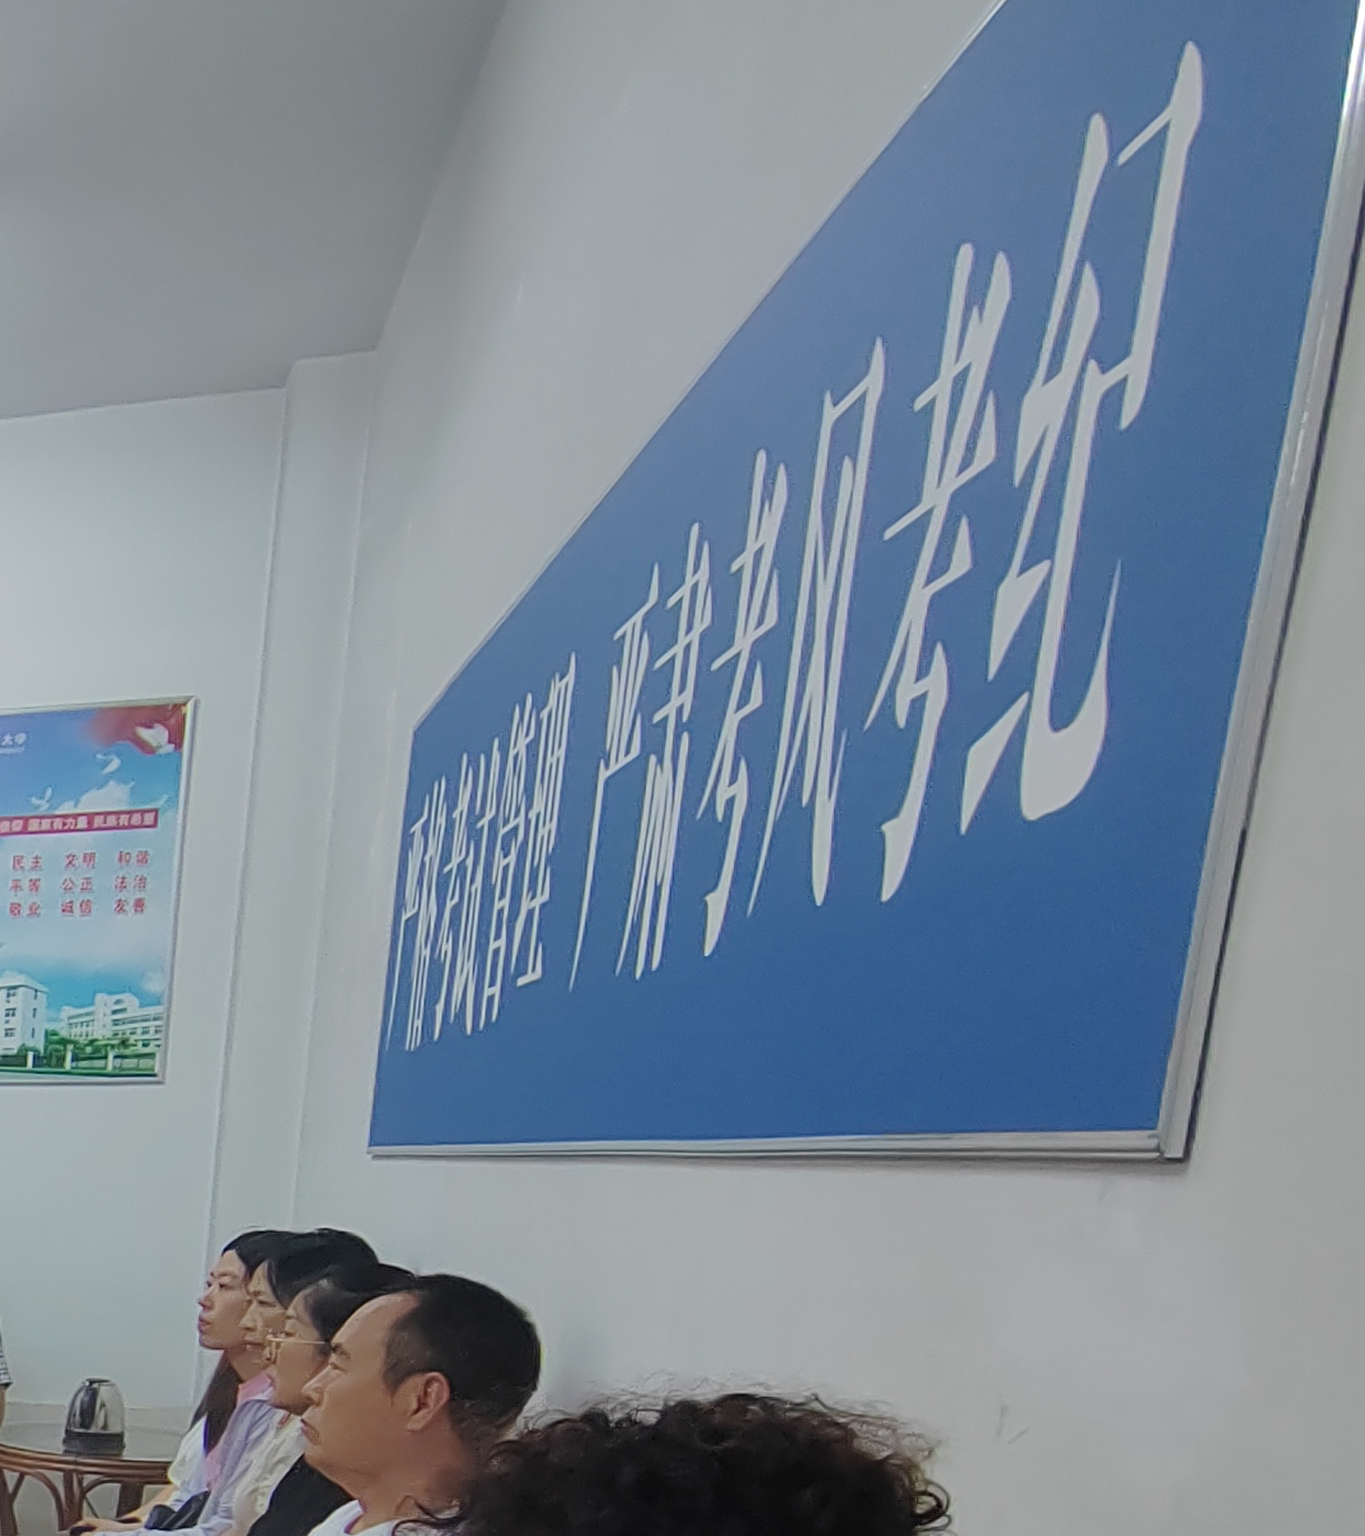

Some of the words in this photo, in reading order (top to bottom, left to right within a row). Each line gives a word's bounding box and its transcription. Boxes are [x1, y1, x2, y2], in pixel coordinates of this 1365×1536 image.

[570, 38, 1205, 992] 严肃考风考纪
[12, 854, 43, 872] 民主
[64, 851, 97, 869] 文明
[117, 849, 150, 867] 和谐
[10, 878, 42, 896] 平等
[61, 876, 93, 894] 公正
[114, 873, 148, 892] 法治
[113, 897, 147, 915] 友善
